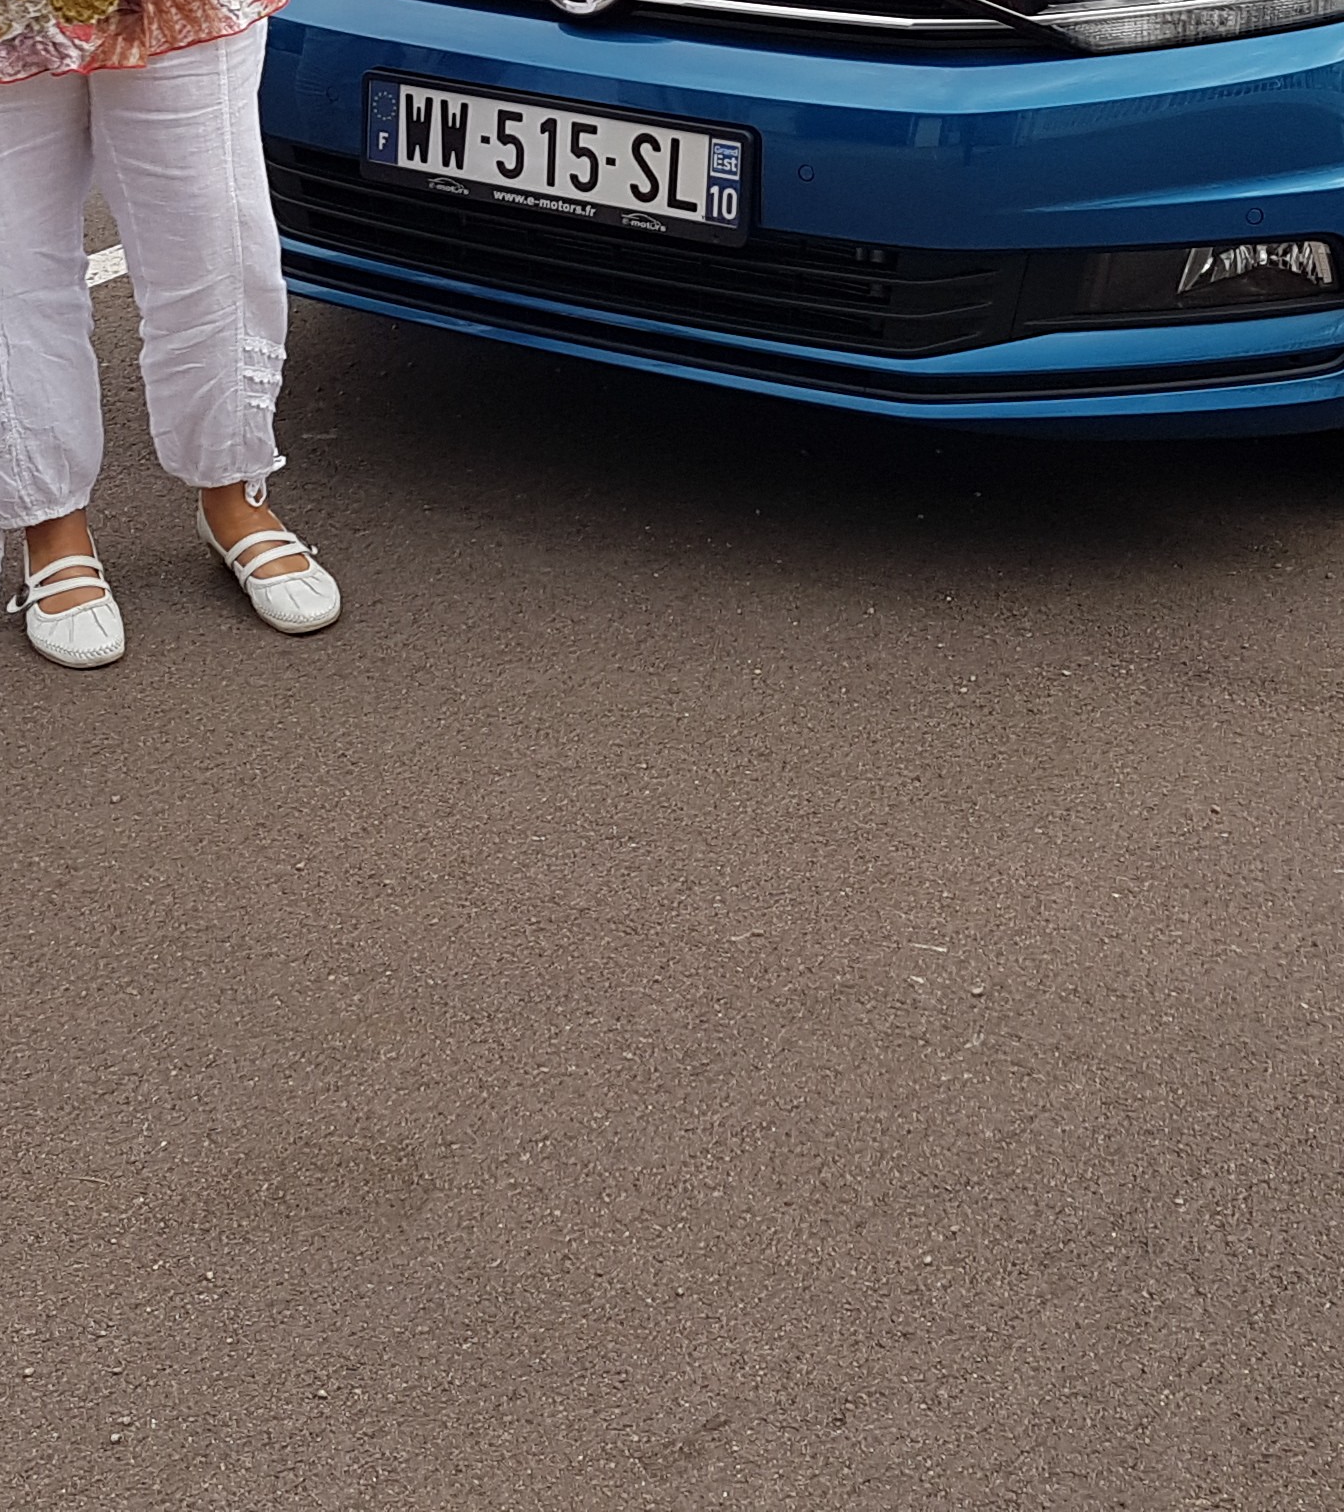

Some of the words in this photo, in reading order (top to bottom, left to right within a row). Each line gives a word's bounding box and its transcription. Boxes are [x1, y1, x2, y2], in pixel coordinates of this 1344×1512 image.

[378, 131, 389, 150] F
[405, 93, 698, 213] WW-515-SL
[713, 154, 738, 171] Est
[493, 189, 597, 217] www.e-motors.fr
[710, 185, 738, 220] 10
